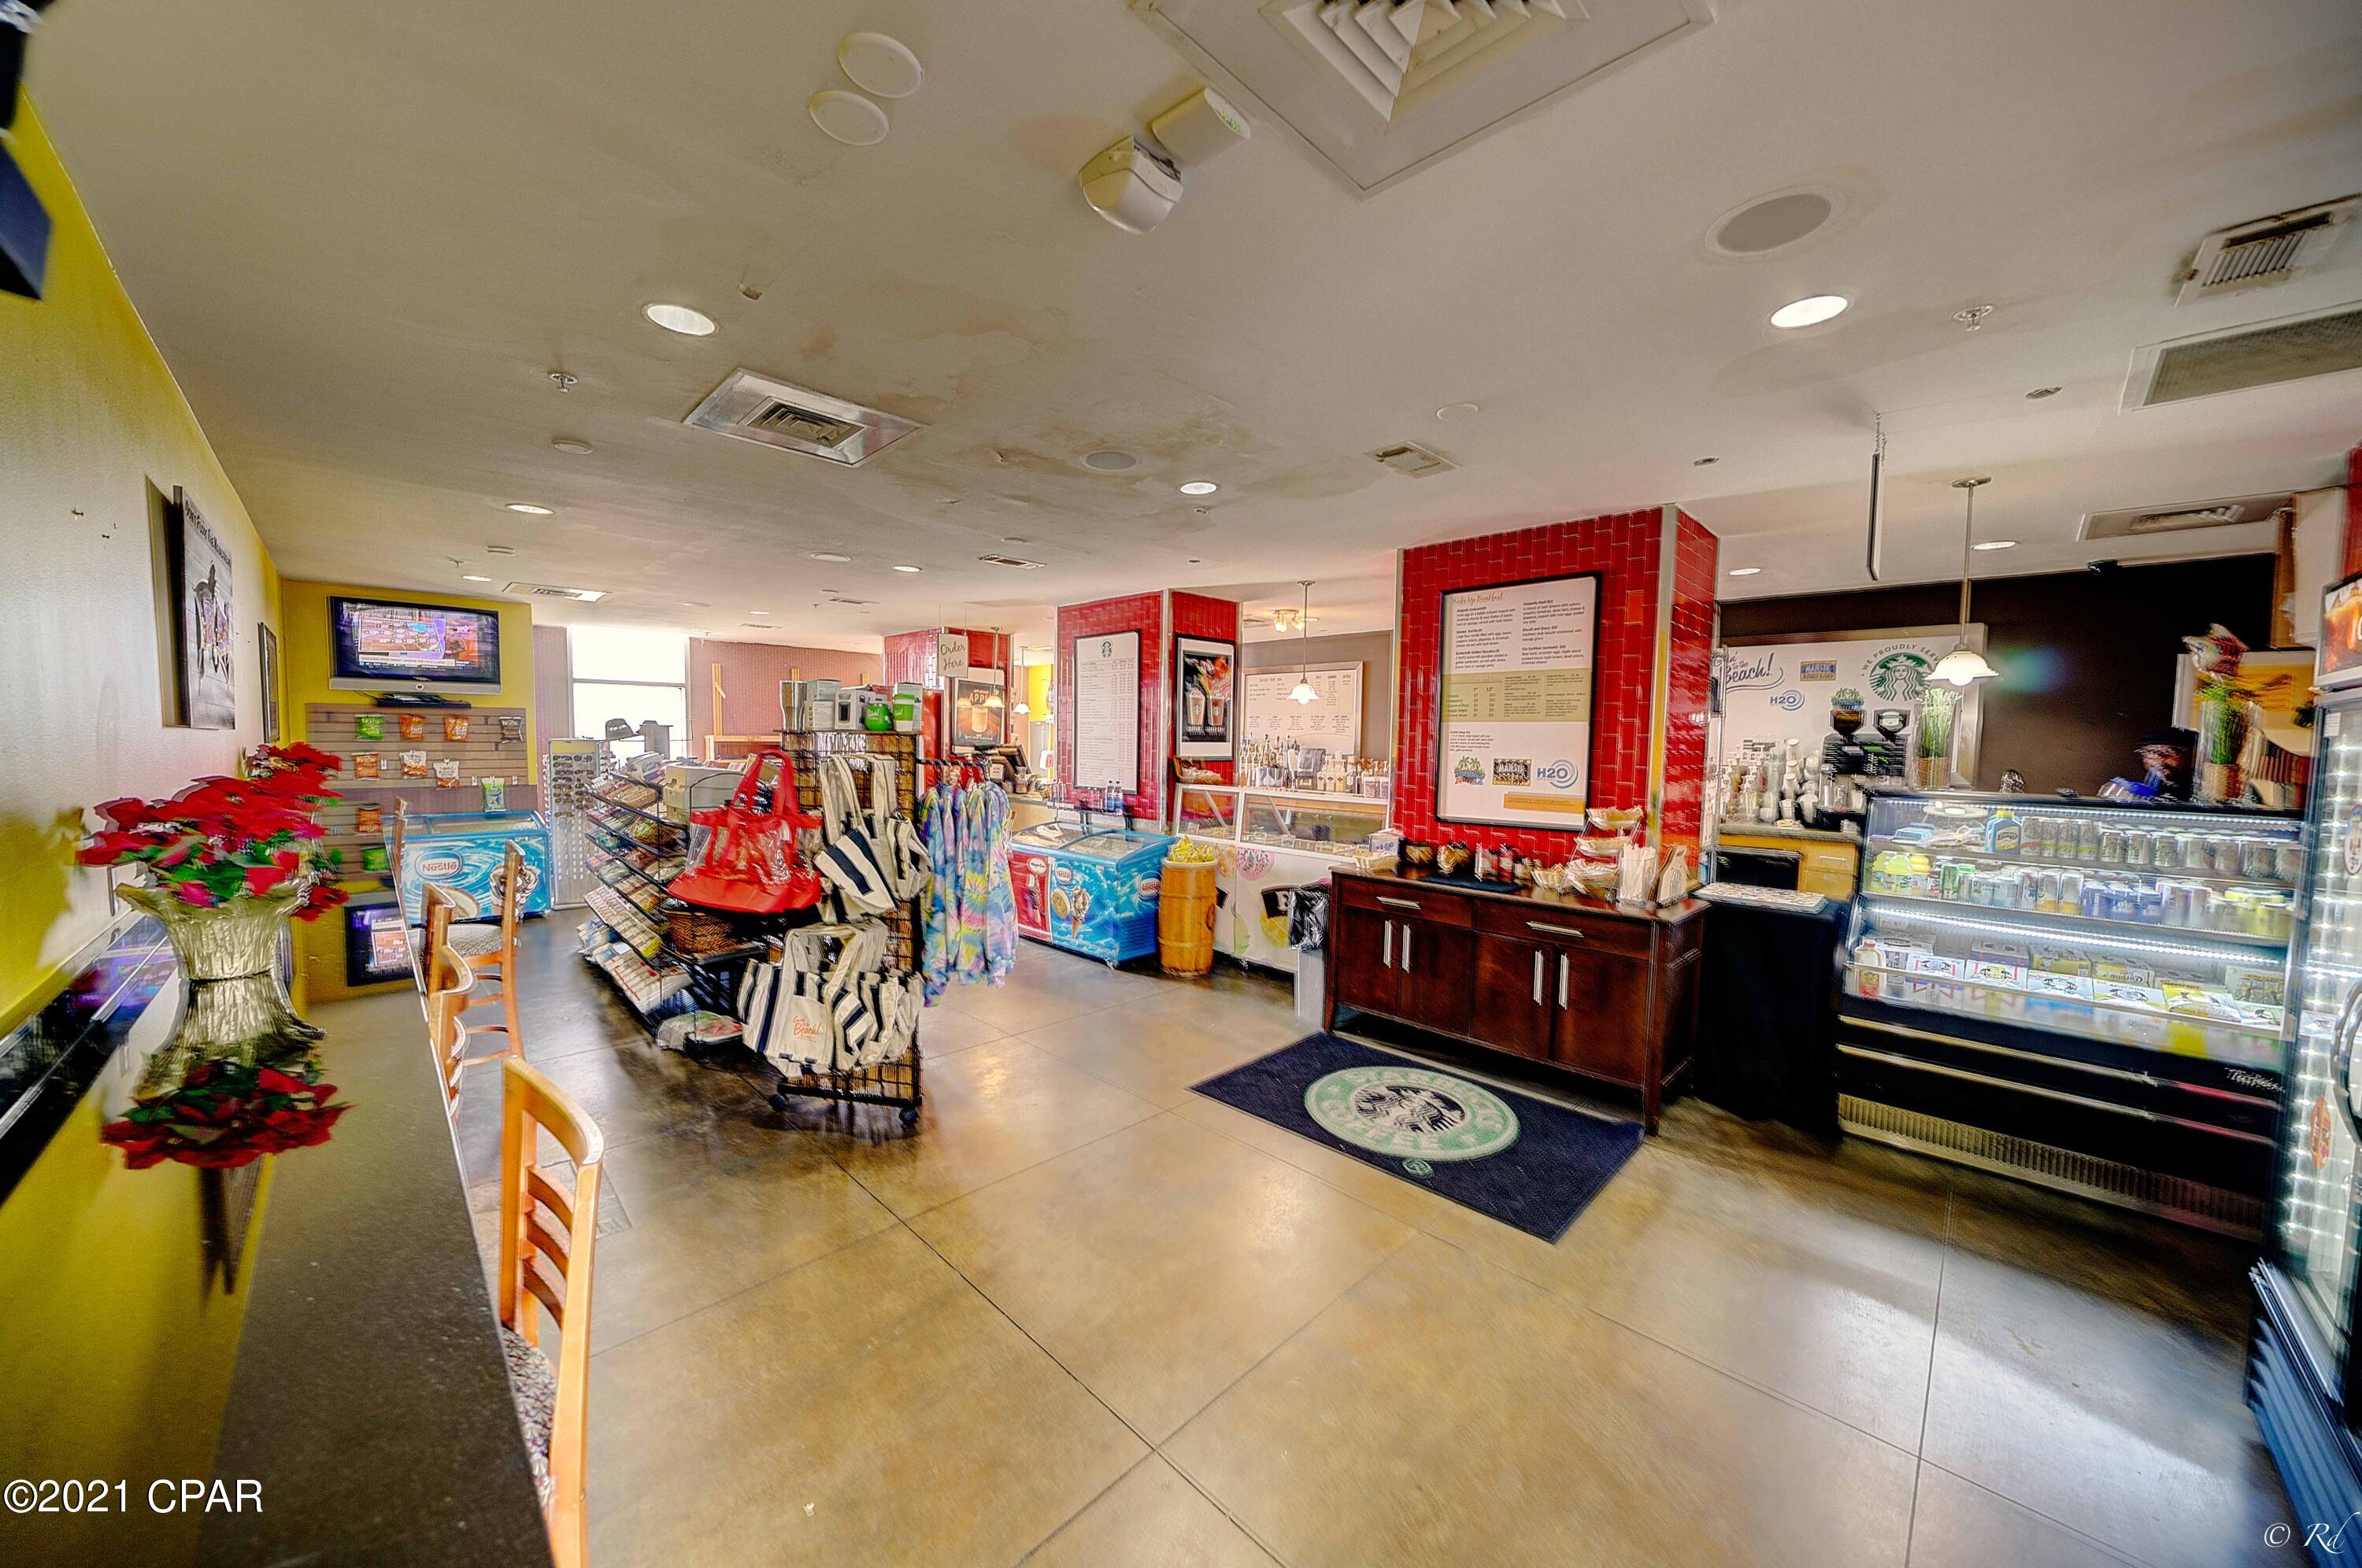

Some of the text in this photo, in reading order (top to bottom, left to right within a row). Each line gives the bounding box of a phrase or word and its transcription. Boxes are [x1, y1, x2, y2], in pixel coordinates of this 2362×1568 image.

[940, 642, 966, 655] Order
[943, 657, 964, 670] Here
[1862, 644, 1941, 670] WE PROUDLY SERV
[1725, 652, 1775, 684] Beach!
[969, 693, 987, 702] APP
[1537, 767, 1568, 779] H2O
[422, 861, 457, 872] Nestlé
